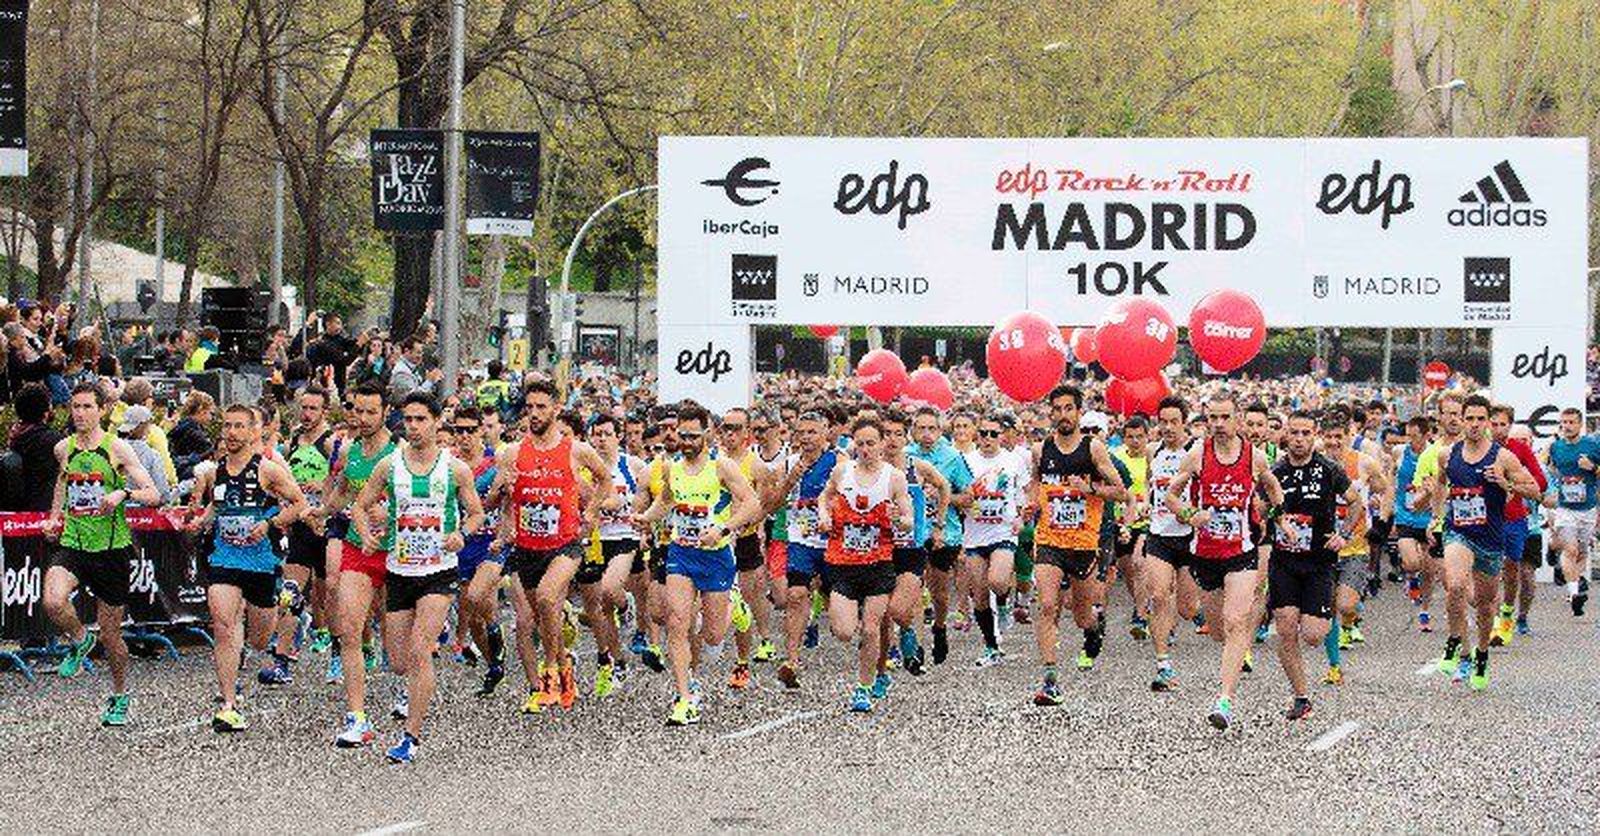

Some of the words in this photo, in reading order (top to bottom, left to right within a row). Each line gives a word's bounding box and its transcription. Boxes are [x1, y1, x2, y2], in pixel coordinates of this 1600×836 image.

[833, 159, 931, 230] edp
[996, 163, 1048, 200] edp
[1055, 170, 1148, 192] Rock
[1178, 170, 1251, 192] Roll
[1316, 159, 1415, 230] edp
[702, 219, 780, 238] iberCaja
[991, 202, 1257, 251] MADRID
[1447, 205, 1548, 227] adidas
[834, 276, 930, 294] MADRID
[1066, 261, 1171, 296] 10K
[1344, 277, 1442, 296] MADRID
[676, 342, 733, 383] edp
[1511, 345, 1569, 387] edp
[2, 555, 41, 617] edp
